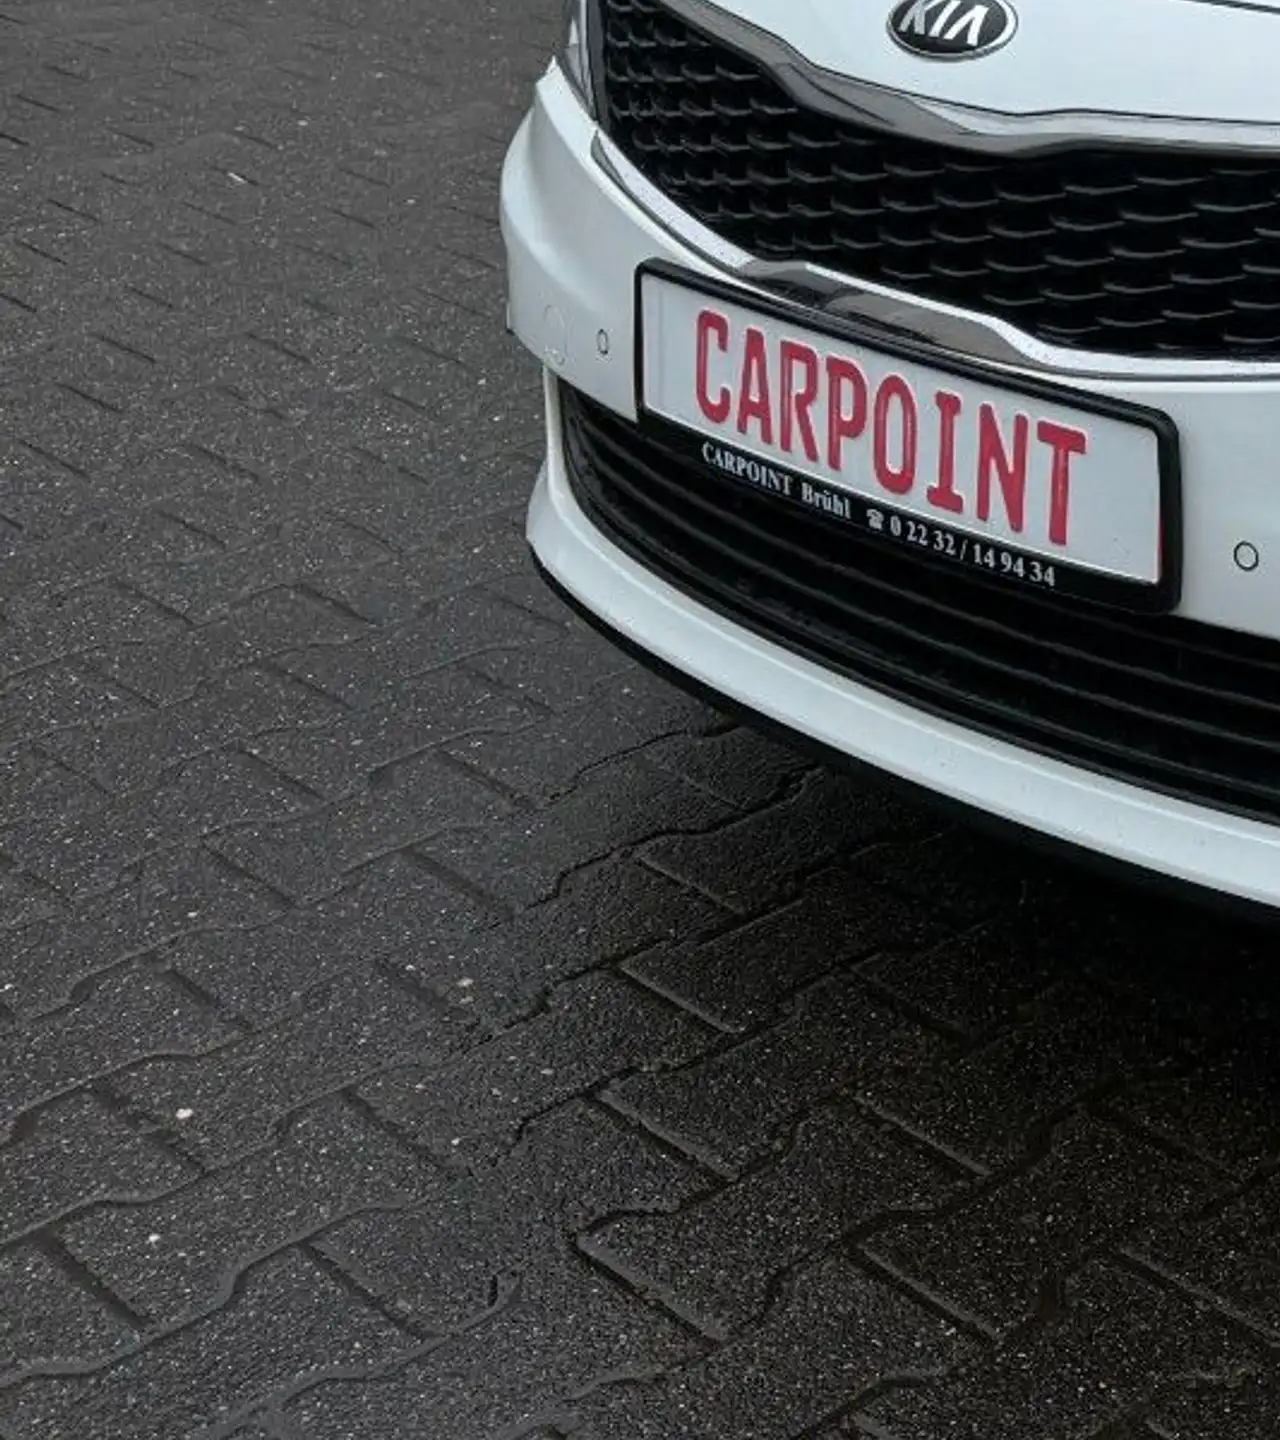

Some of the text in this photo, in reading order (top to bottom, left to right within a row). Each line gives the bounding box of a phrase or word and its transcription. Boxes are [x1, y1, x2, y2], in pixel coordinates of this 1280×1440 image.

[694, 309, 1087, 547] CARPOINT
[702, 441, 794, 496] CARPOINT
[801, 482, 852, 519] Brühl
[890, 515, 902, 536] 0
[907, 521, 928, 546] 22
[933, 530, 956, 556] 32
[973, 544, 995, 568] 14
[1000, 552, 1024, 578] 94
[1029, 561, 1056, 587] 34
